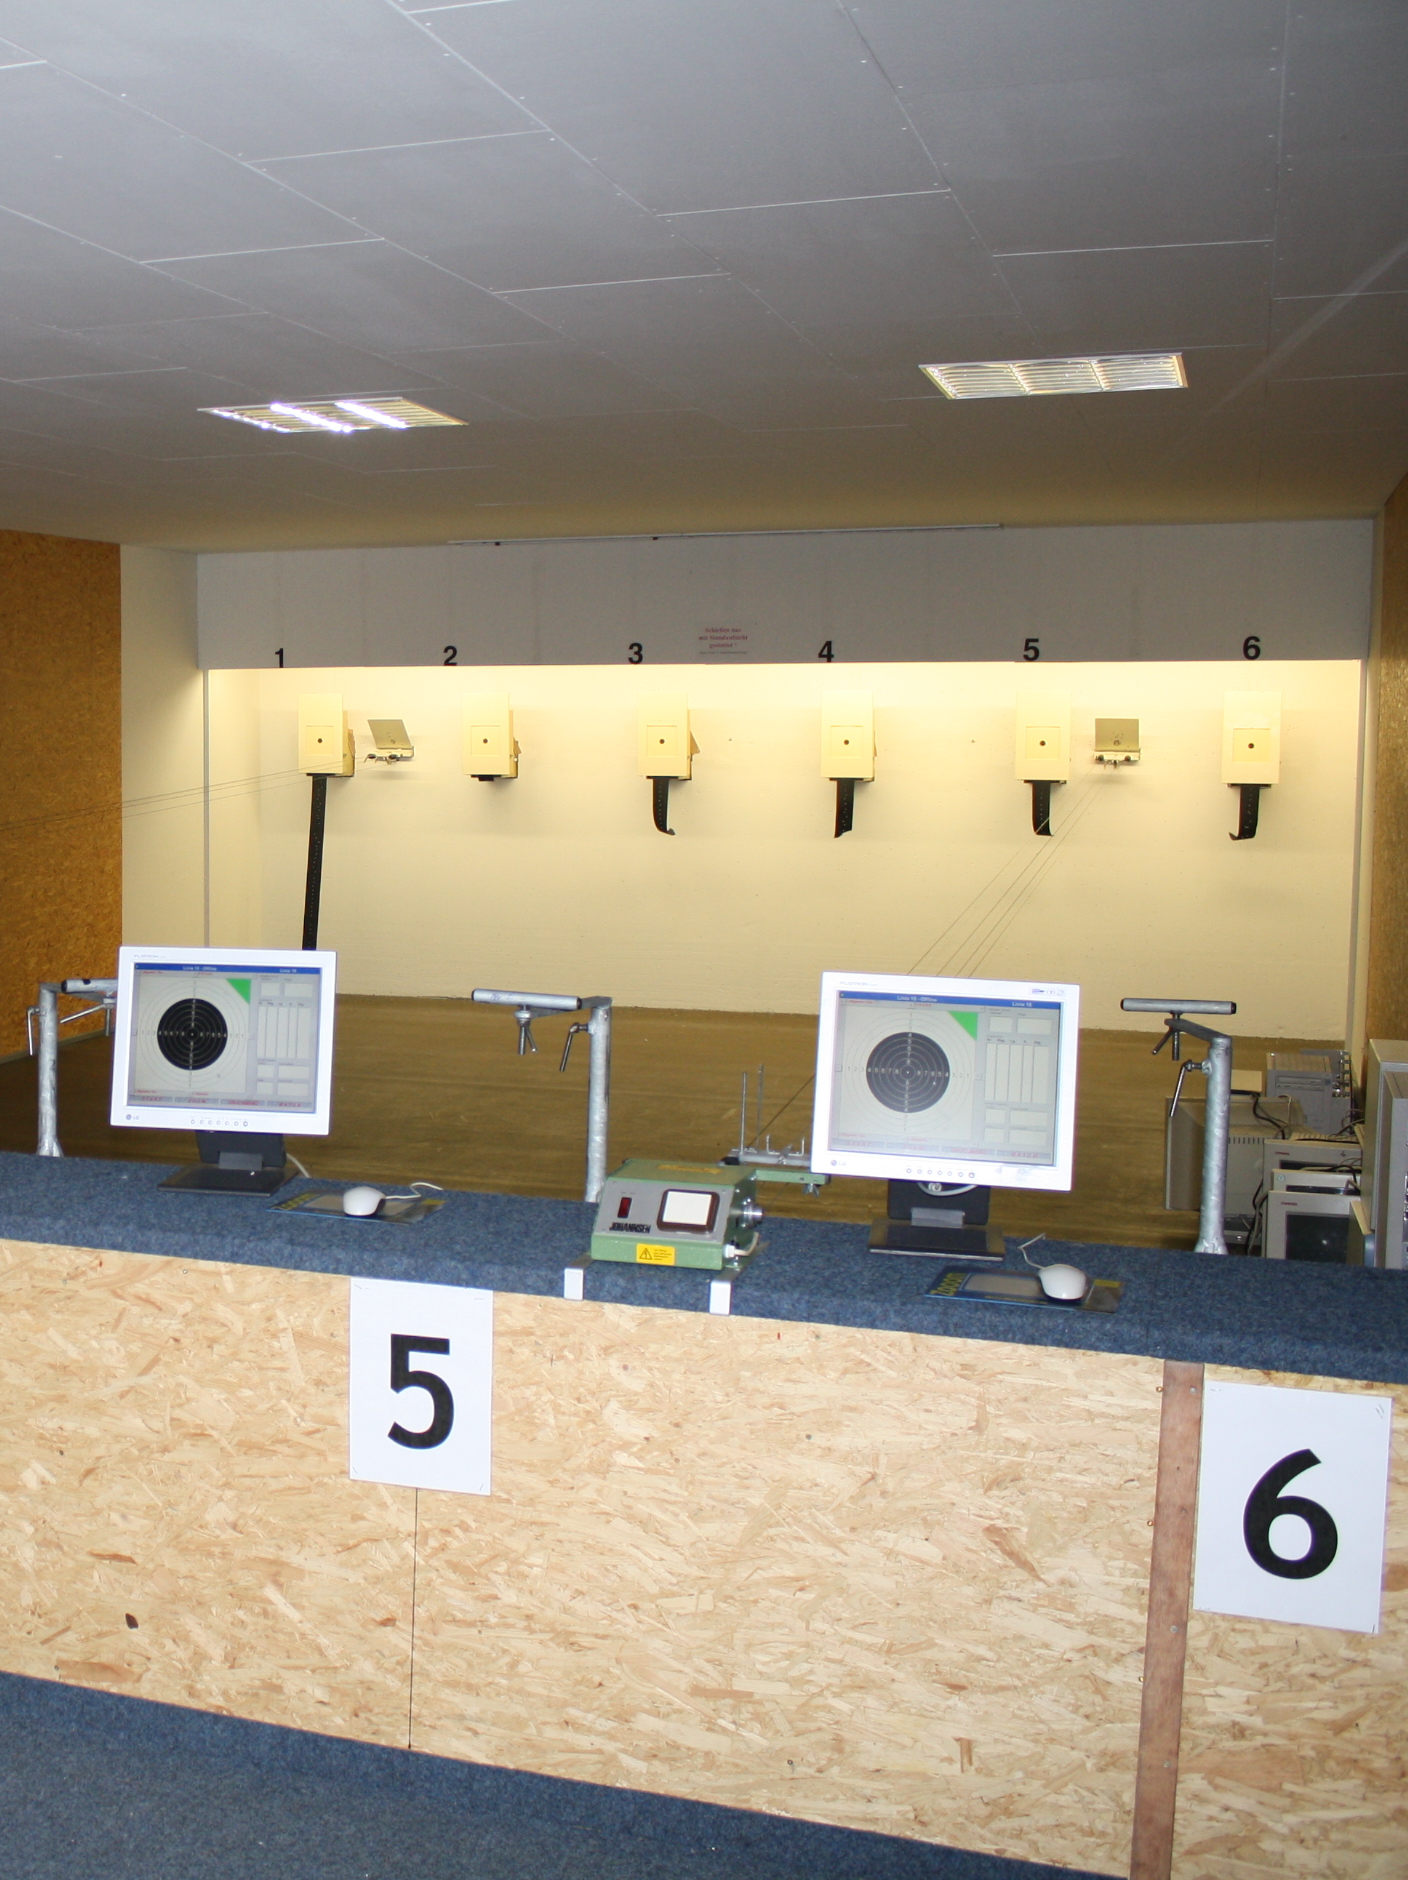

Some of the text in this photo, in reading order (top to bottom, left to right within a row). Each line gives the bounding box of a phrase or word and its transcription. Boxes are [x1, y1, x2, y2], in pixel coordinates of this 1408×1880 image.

[274, 647, 285, 668] 1
[443, 645, 458, 666] 2
[628, 642, 644, 665] 3
[817, 640, 835, 663] 4
[1022, 637, 1040, 662] 5
[1242, 635, 1261, 661] 6
[609, 1221, 652, 1234] JOHANNSEN
[387, 1334, 455, 1450] 5
[1243, 1449, 1338, 1580] 6
